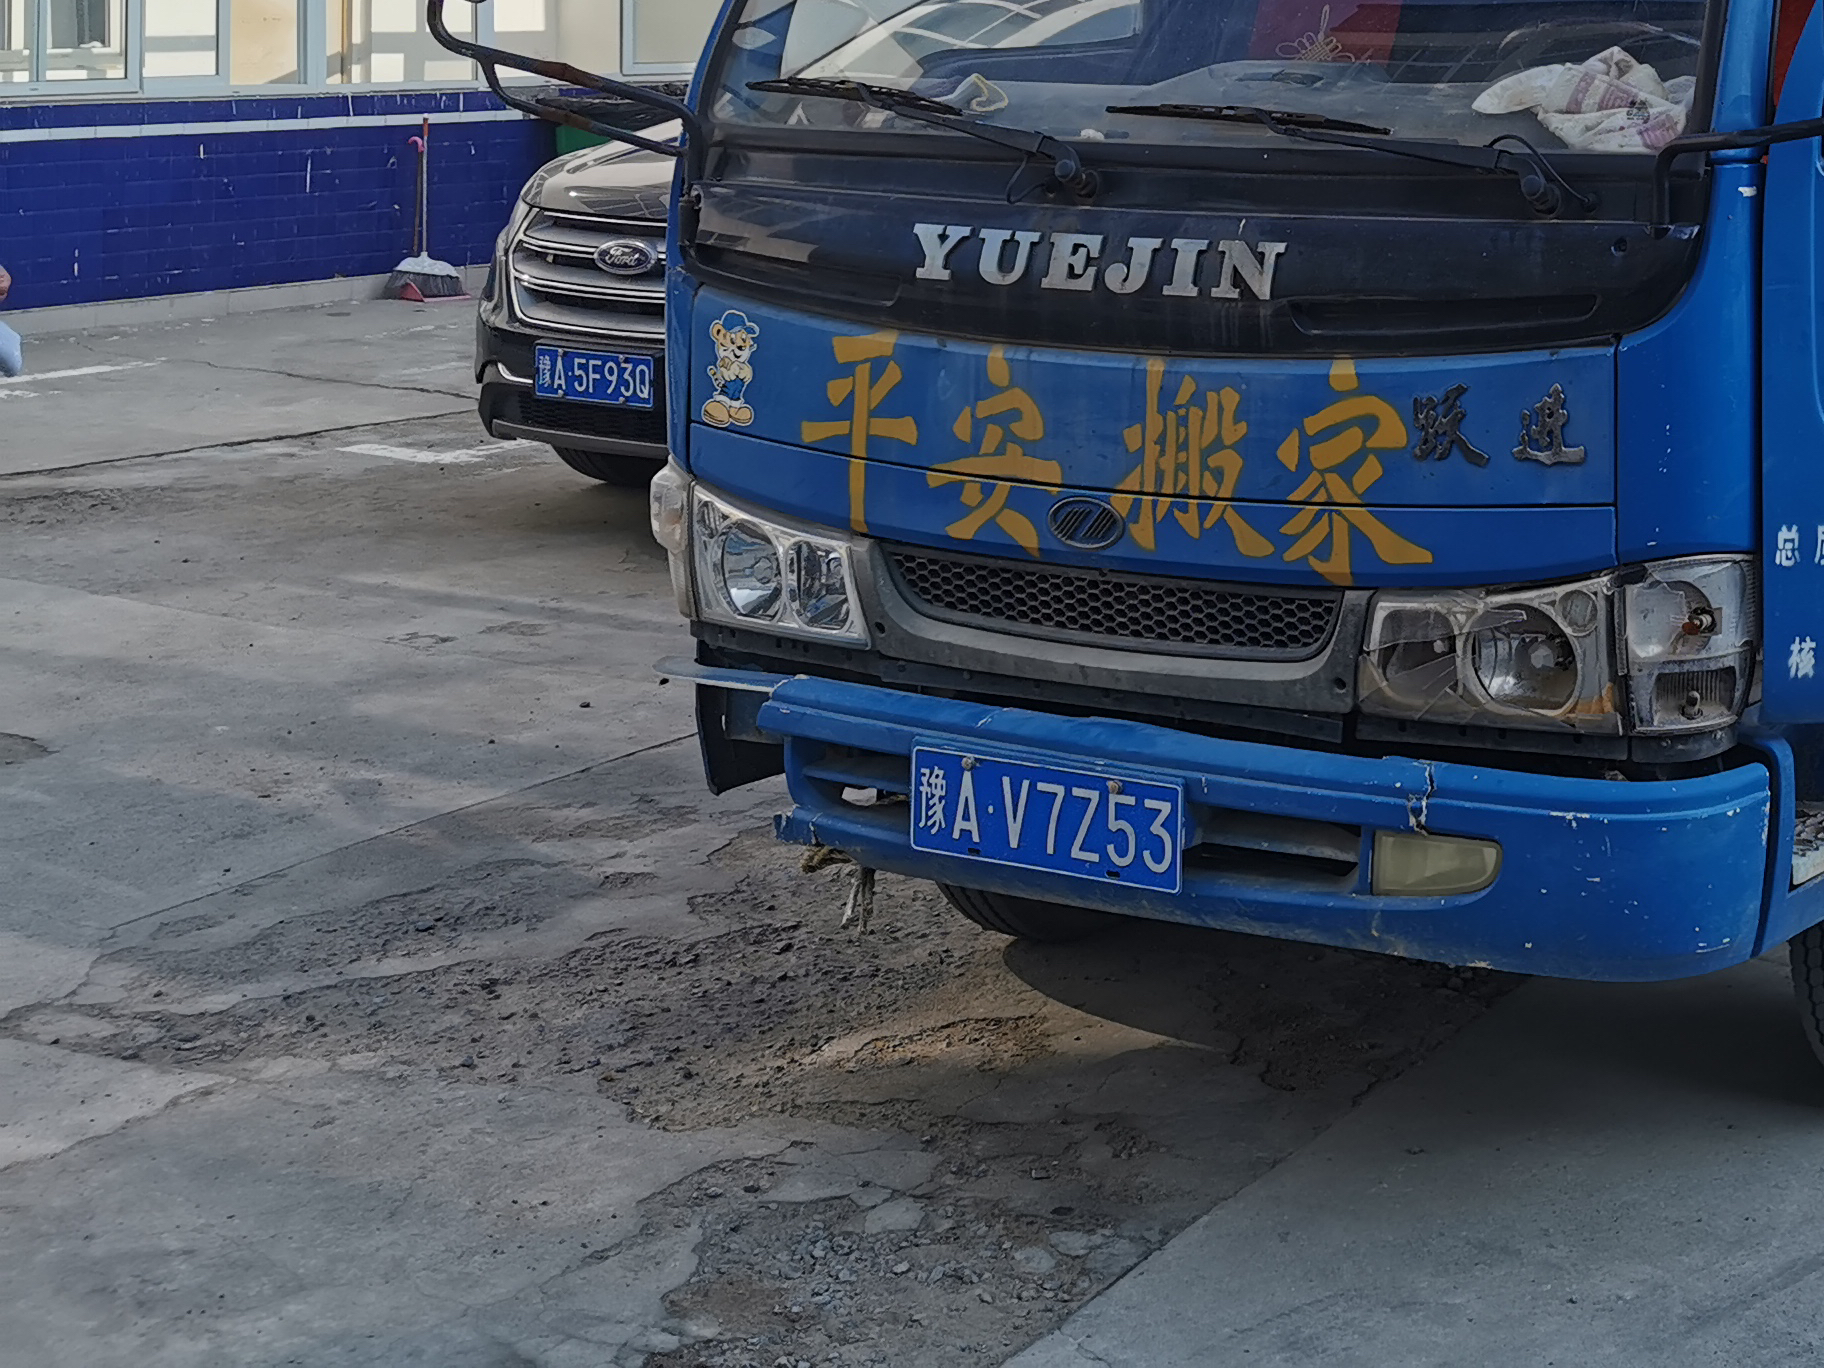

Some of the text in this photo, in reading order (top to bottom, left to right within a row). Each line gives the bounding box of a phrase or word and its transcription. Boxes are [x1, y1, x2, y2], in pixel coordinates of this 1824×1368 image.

[605, 246, 639, 266] Ford
[912, 222, 1288, 301] YUEJIN
[801, 331, 1434, 587] 平安搬家
[1412, 382, 1587, 467] 跃进
